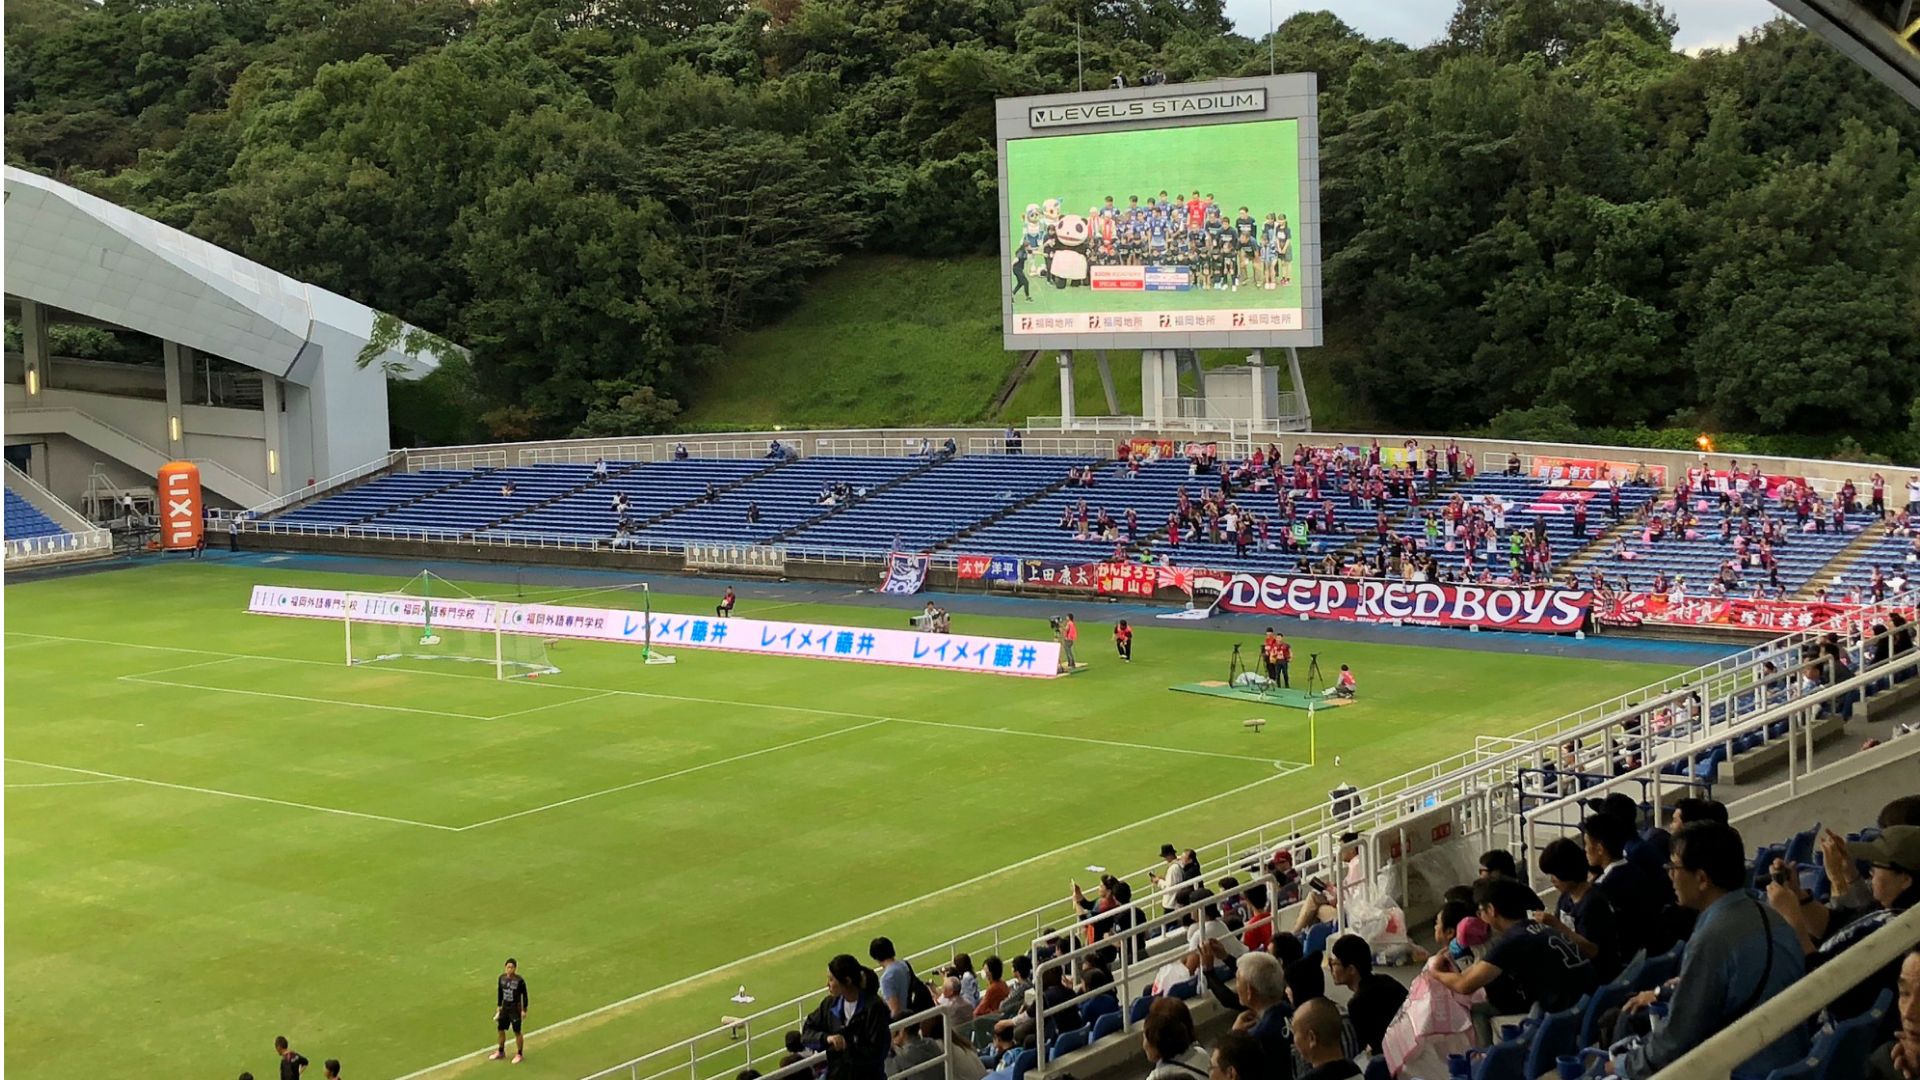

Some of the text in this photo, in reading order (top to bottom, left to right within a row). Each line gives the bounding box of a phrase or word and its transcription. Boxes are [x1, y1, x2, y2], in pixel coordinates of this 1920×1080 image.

[1035, 318, 1073, 328] 福岡地所
[1104, 316, 1142, 327] 福岡地所
[1175, 315, 1216, 326] 福岡地所
[1248, 313, 1291, 325] 福岡地所
[169, 473, 193, 544] LIXIL
[1027, 564, 1090, 586] 上田康太
[1097, 562, 1156, 580] がんばろう
[1229, 573, 1585, 632] DEEP RED BOYS
[761, 625, 875, 656] レイメイ藤井
[913, 637, 1037, 669] レイメイ藤井
